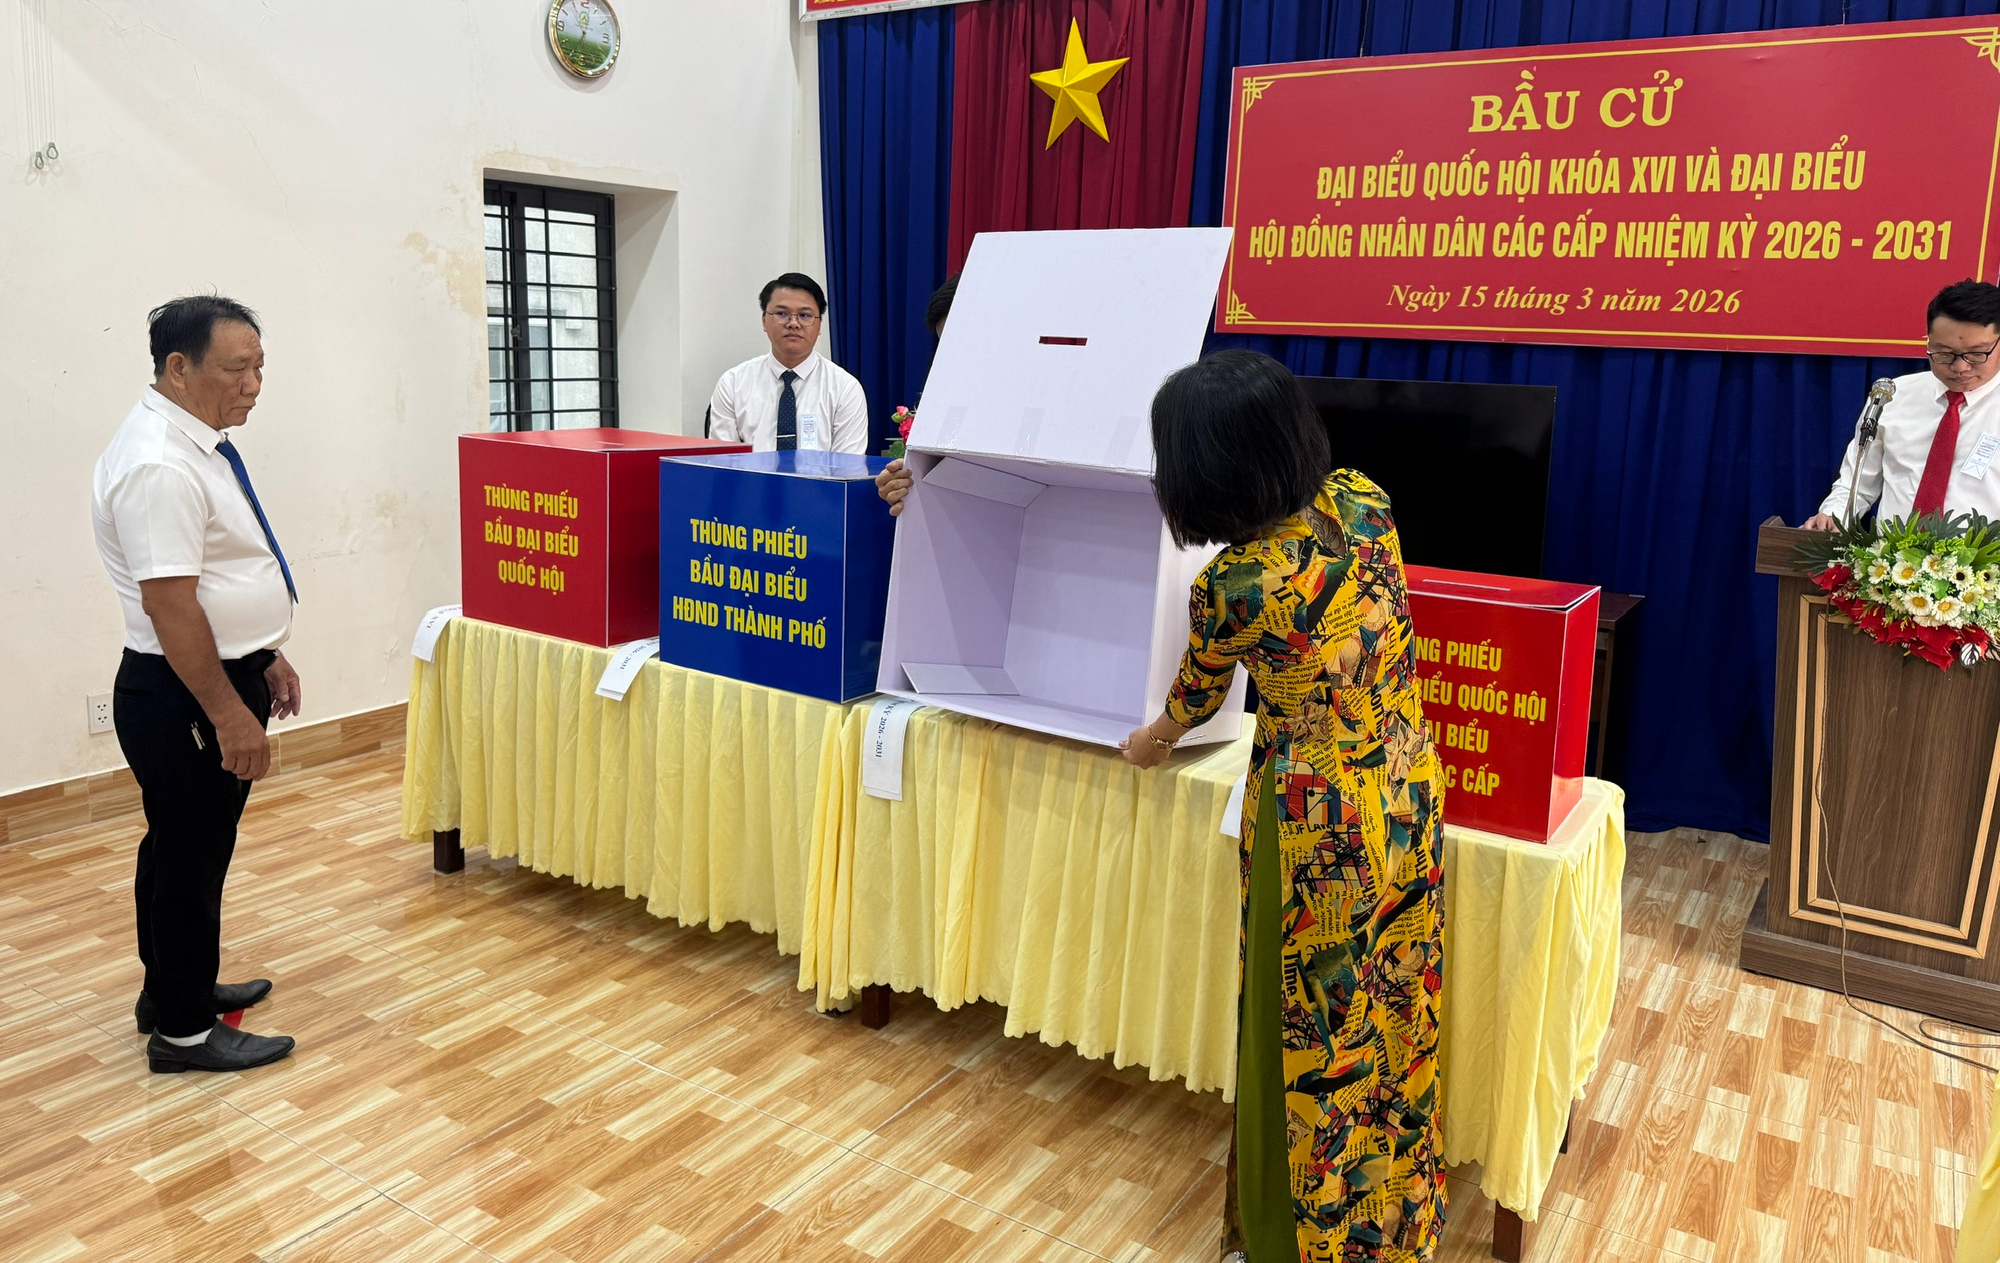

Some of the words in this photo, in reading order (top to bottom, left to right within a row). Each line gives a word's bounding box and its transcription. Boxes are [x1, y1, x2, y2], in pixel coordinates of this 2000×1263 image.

[1468, 69, 1581, 133] BẦU
[1599, 69, 1684, 128] CỬ
[1317, 166, 1356, 207] ĐẠI
[1361, 149, 1417, 199] BIỂU
[1423, 148, 1490, 201] QUỐC
[1496, 152, 1542, 203] HỘI
[1548, 150, 1621, 195] KHÓA
[1628, 155, 1677, 194] XVI
[1686, 146, 1721, 193] VÀ
[1730, 152, 1784, 200] ĐẠI
[1791, 134, 1866, 191] BIỂU
[1249, 218, 1286, 265] HỘI
[1291, 213, 1353, 258] ĐỒNG
[1359, 216, 1427, 258] NHÂN
[1432, 215, 1486, 257] DÂN
[1492, 214, 1545, 258] CÁC
[1552, 208, 1607, 258] CẤP
[1614, 213, 1710, 267] NHIỆM
[1717, 212, 1758, 259] KỲ
[1764, 220, 1842, 260] 2026
[1851, 238, 1863, 247] -
[1872, 219, 1952, 261] 2031
[1386, 284, 1451, 313] Ngày
[1457, 285, 1488, 308] 15
[1494, 286, 1570, 316] tháng
[1577, 287, 1594, 311] 3
[1600, 288, 1661, 312] năm
[1670, 288, 1744, 314] 2026
[484, 483, 530, 512] THÙNG
[534, 489, 578, 519] PHIẾU
[485, 515, 513, 546] BẦU
[516, 526, 541, 555] ĐẠI
[545, 525, 579, 557] BIỂU
[690, 516, 747, 550] THÙNG
[752, 525, 807, 560] PHIẾU
[498, 556, 536, 587] QUỐC
[540, 564, 565, 596] HỘI
[690, 553, 725, 588] BẦU
[729, 565, 759, 597] ĐẠI
[765, 565, 807, 602] BIỂU
[672, 595, 719, 628] HĐND
[724, 604, 783, 641] THÀNH
[788, 616, 827, 650] PHỐ
[1413, 636, 1441, 663] NG
[1446, 638, 1502, 672] PHIẾU
[1457, 680, 1509, 715] QUỐC
[1513, 690, 1547, 726] HỘI
[878, 716, 887, 734] 2026
[1446, 717, 1489, 754] BIỂU
[875, 740, 883, 758] 2031
[1462, 763, 1500, 797] CẤP
[1284, 949, 1301, 998] Time
